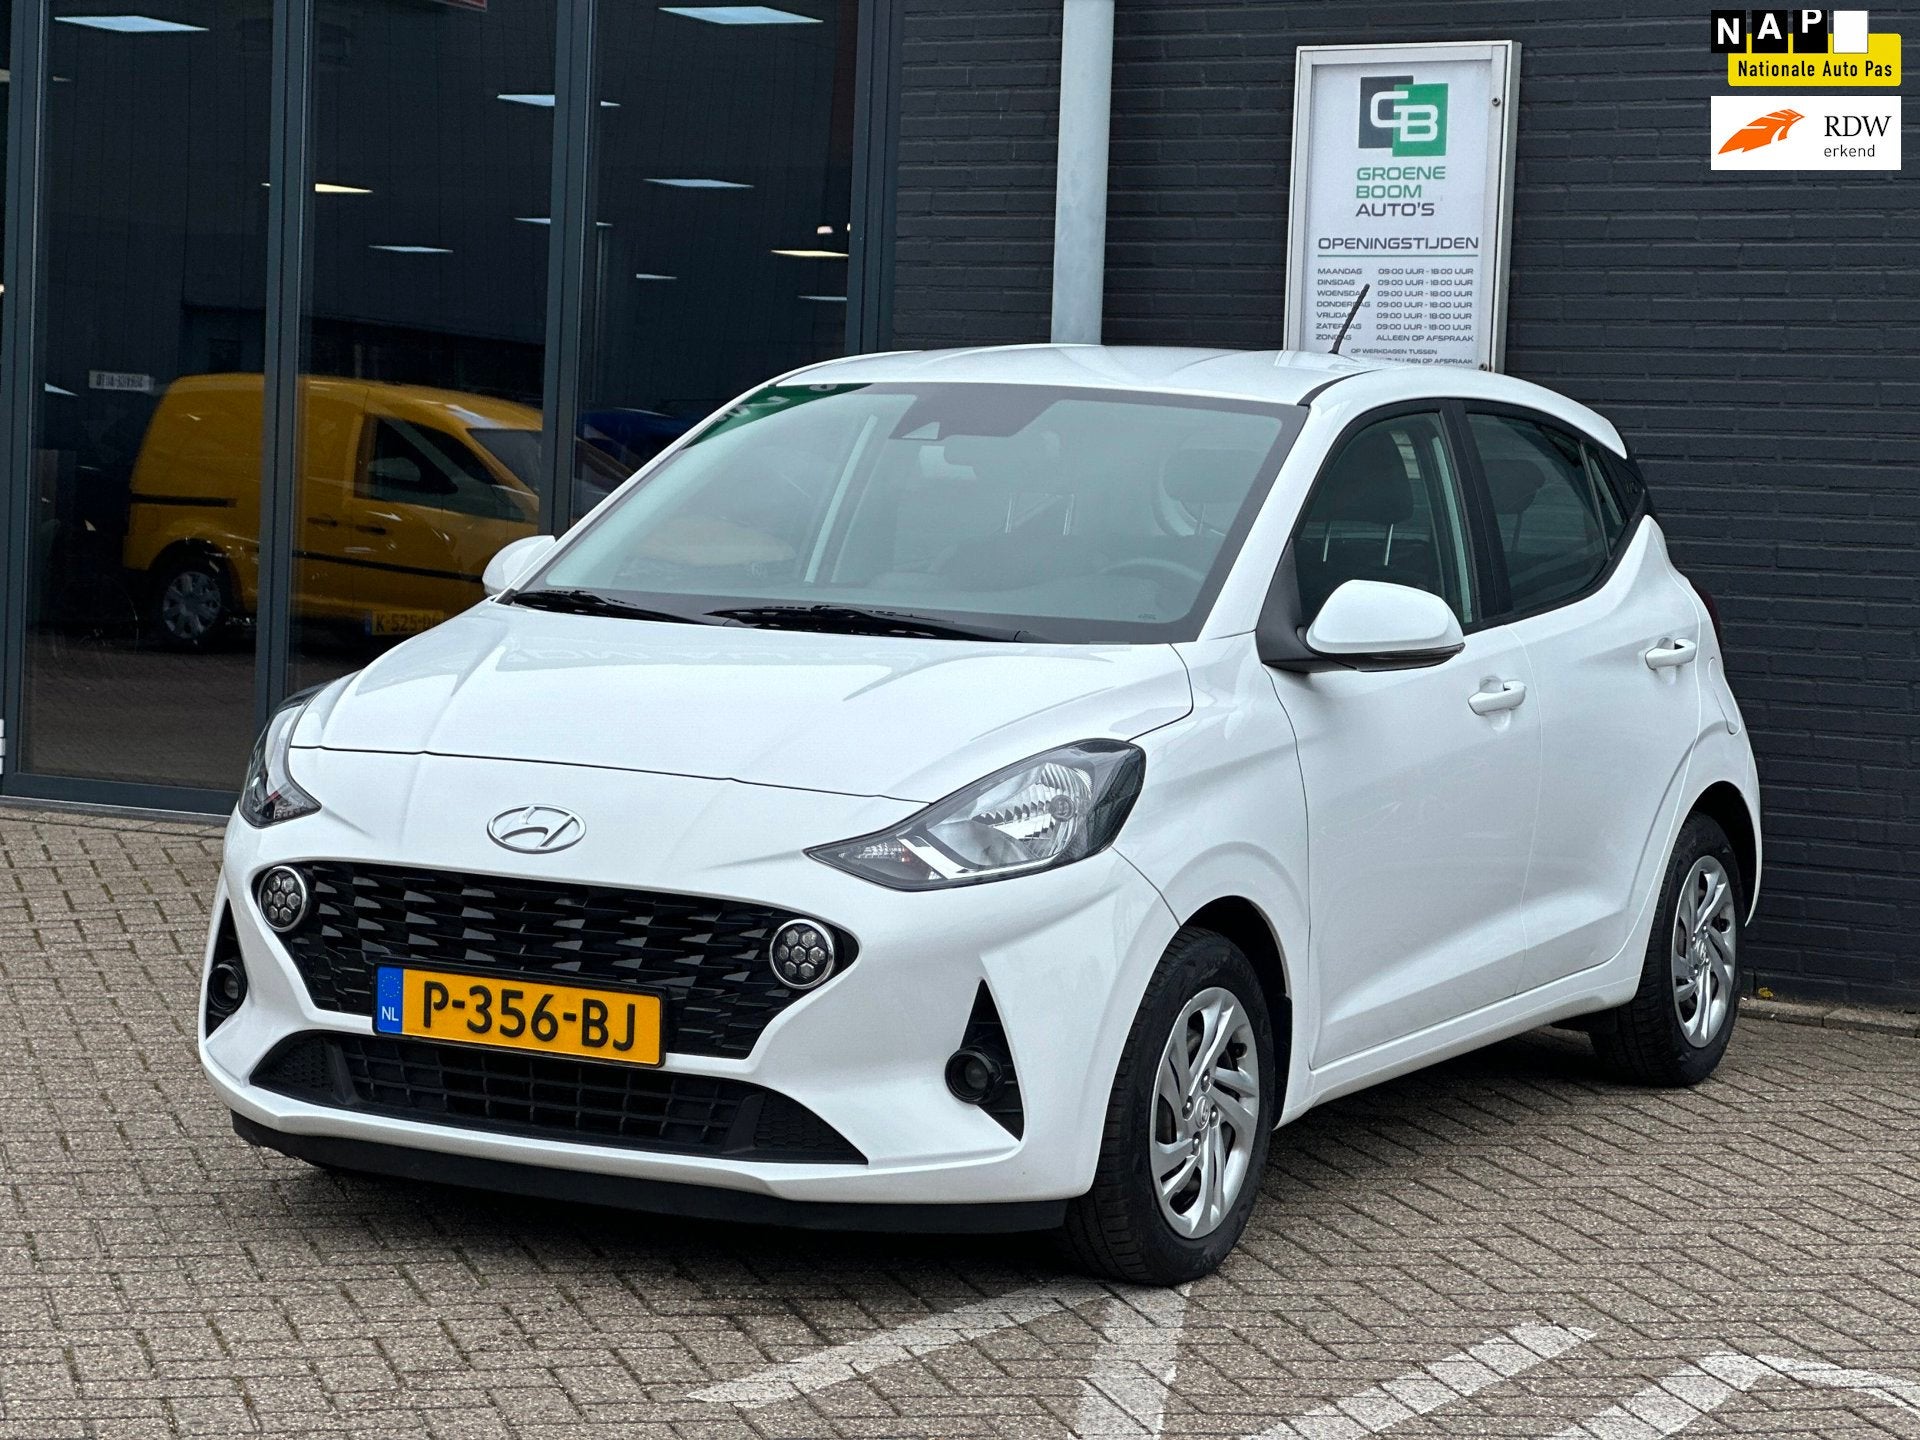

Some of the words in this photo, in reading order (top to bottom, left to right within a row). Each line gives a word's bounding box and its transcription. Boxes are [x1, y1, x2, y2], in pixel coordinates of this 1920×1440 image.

[1356, 166, 1446, 181] GROENE
[1356, 184, 1422, 199] BOOM
[1355, 202, 1435, 217] AUTO'S
[1318, 236, 1479, 250] OPENINGSTIJDEN
[381, 1006, 399, 1022] NL
[423, 980, 636, 1051] P-356-BJ
